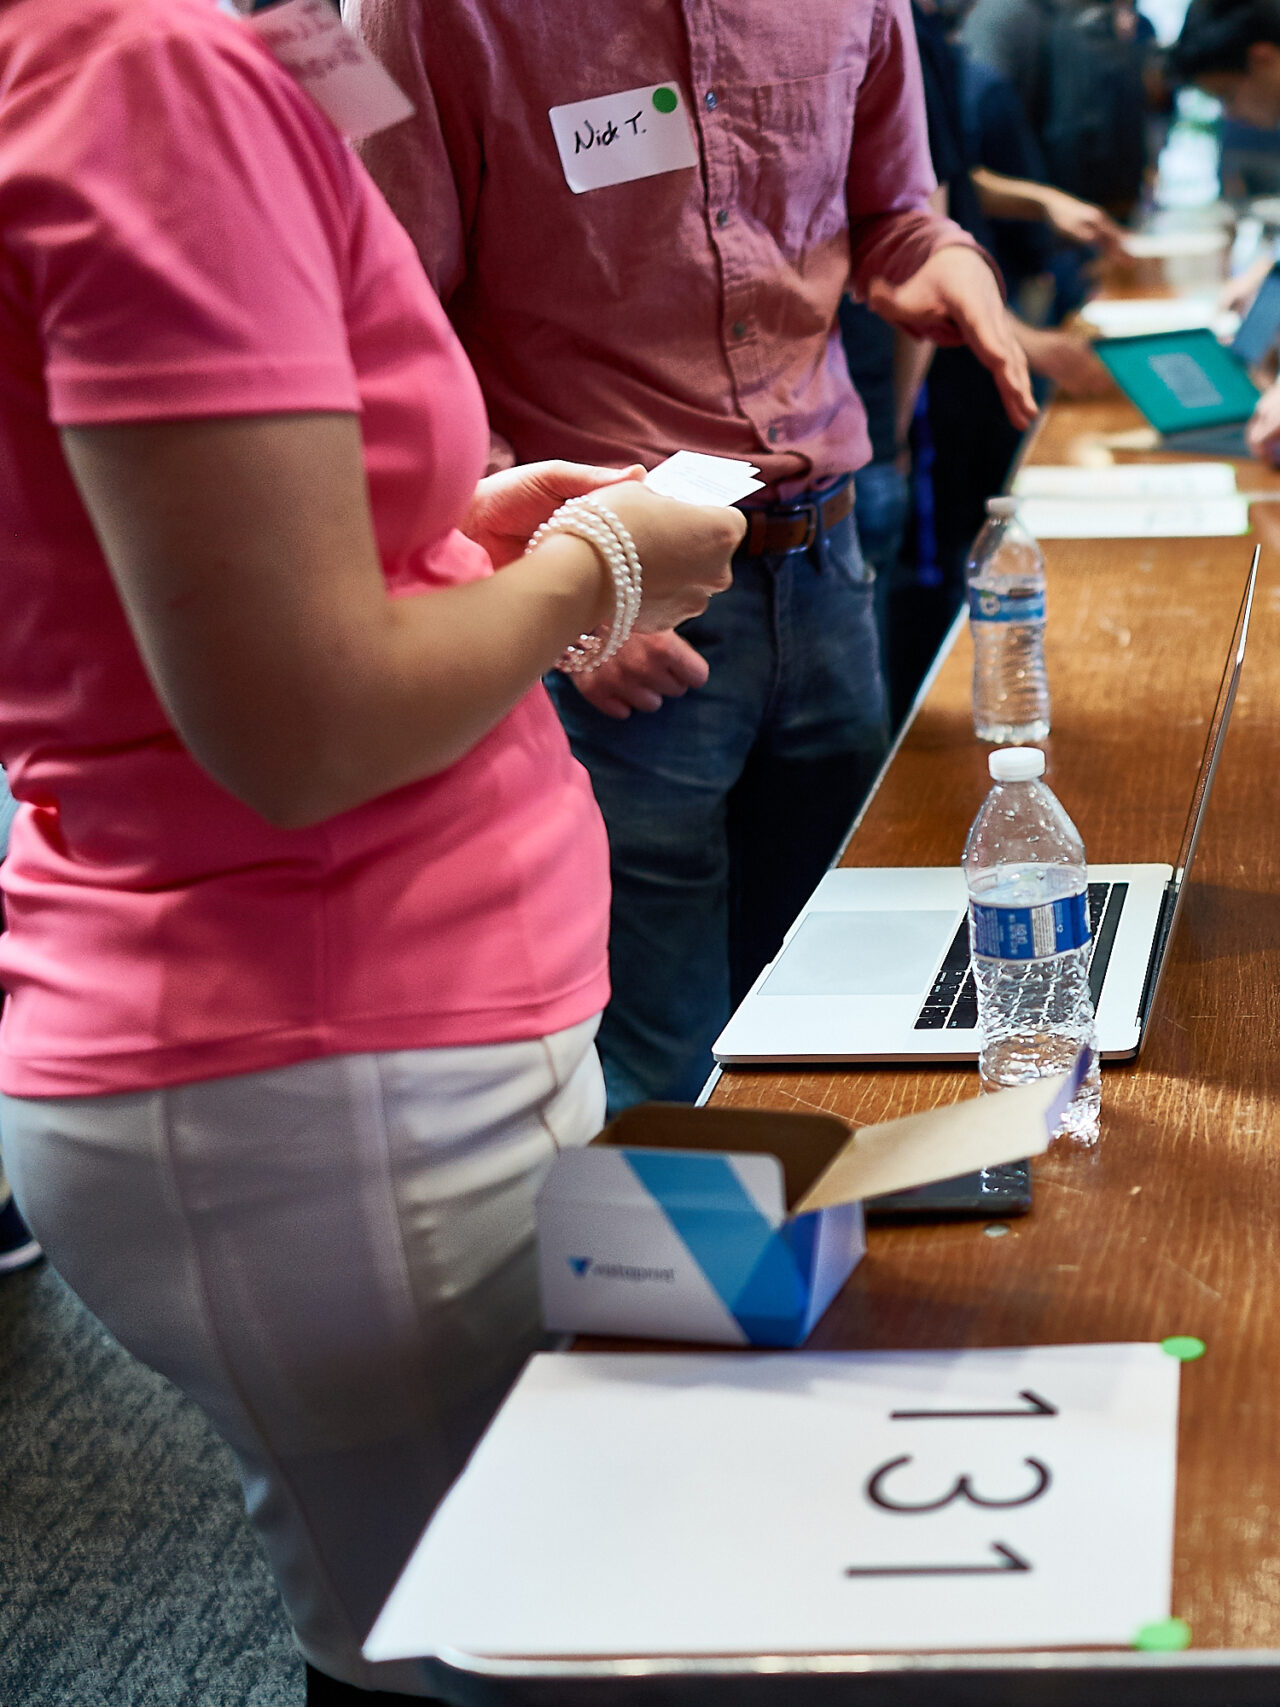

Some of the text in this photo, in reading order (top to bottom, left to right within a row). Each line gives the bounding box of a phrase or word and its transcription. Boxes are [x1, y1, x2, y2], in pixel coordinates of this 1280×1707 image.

[573, 111, 647, 154] Nick T.
[844, 1388, 1060, 1578] 131
